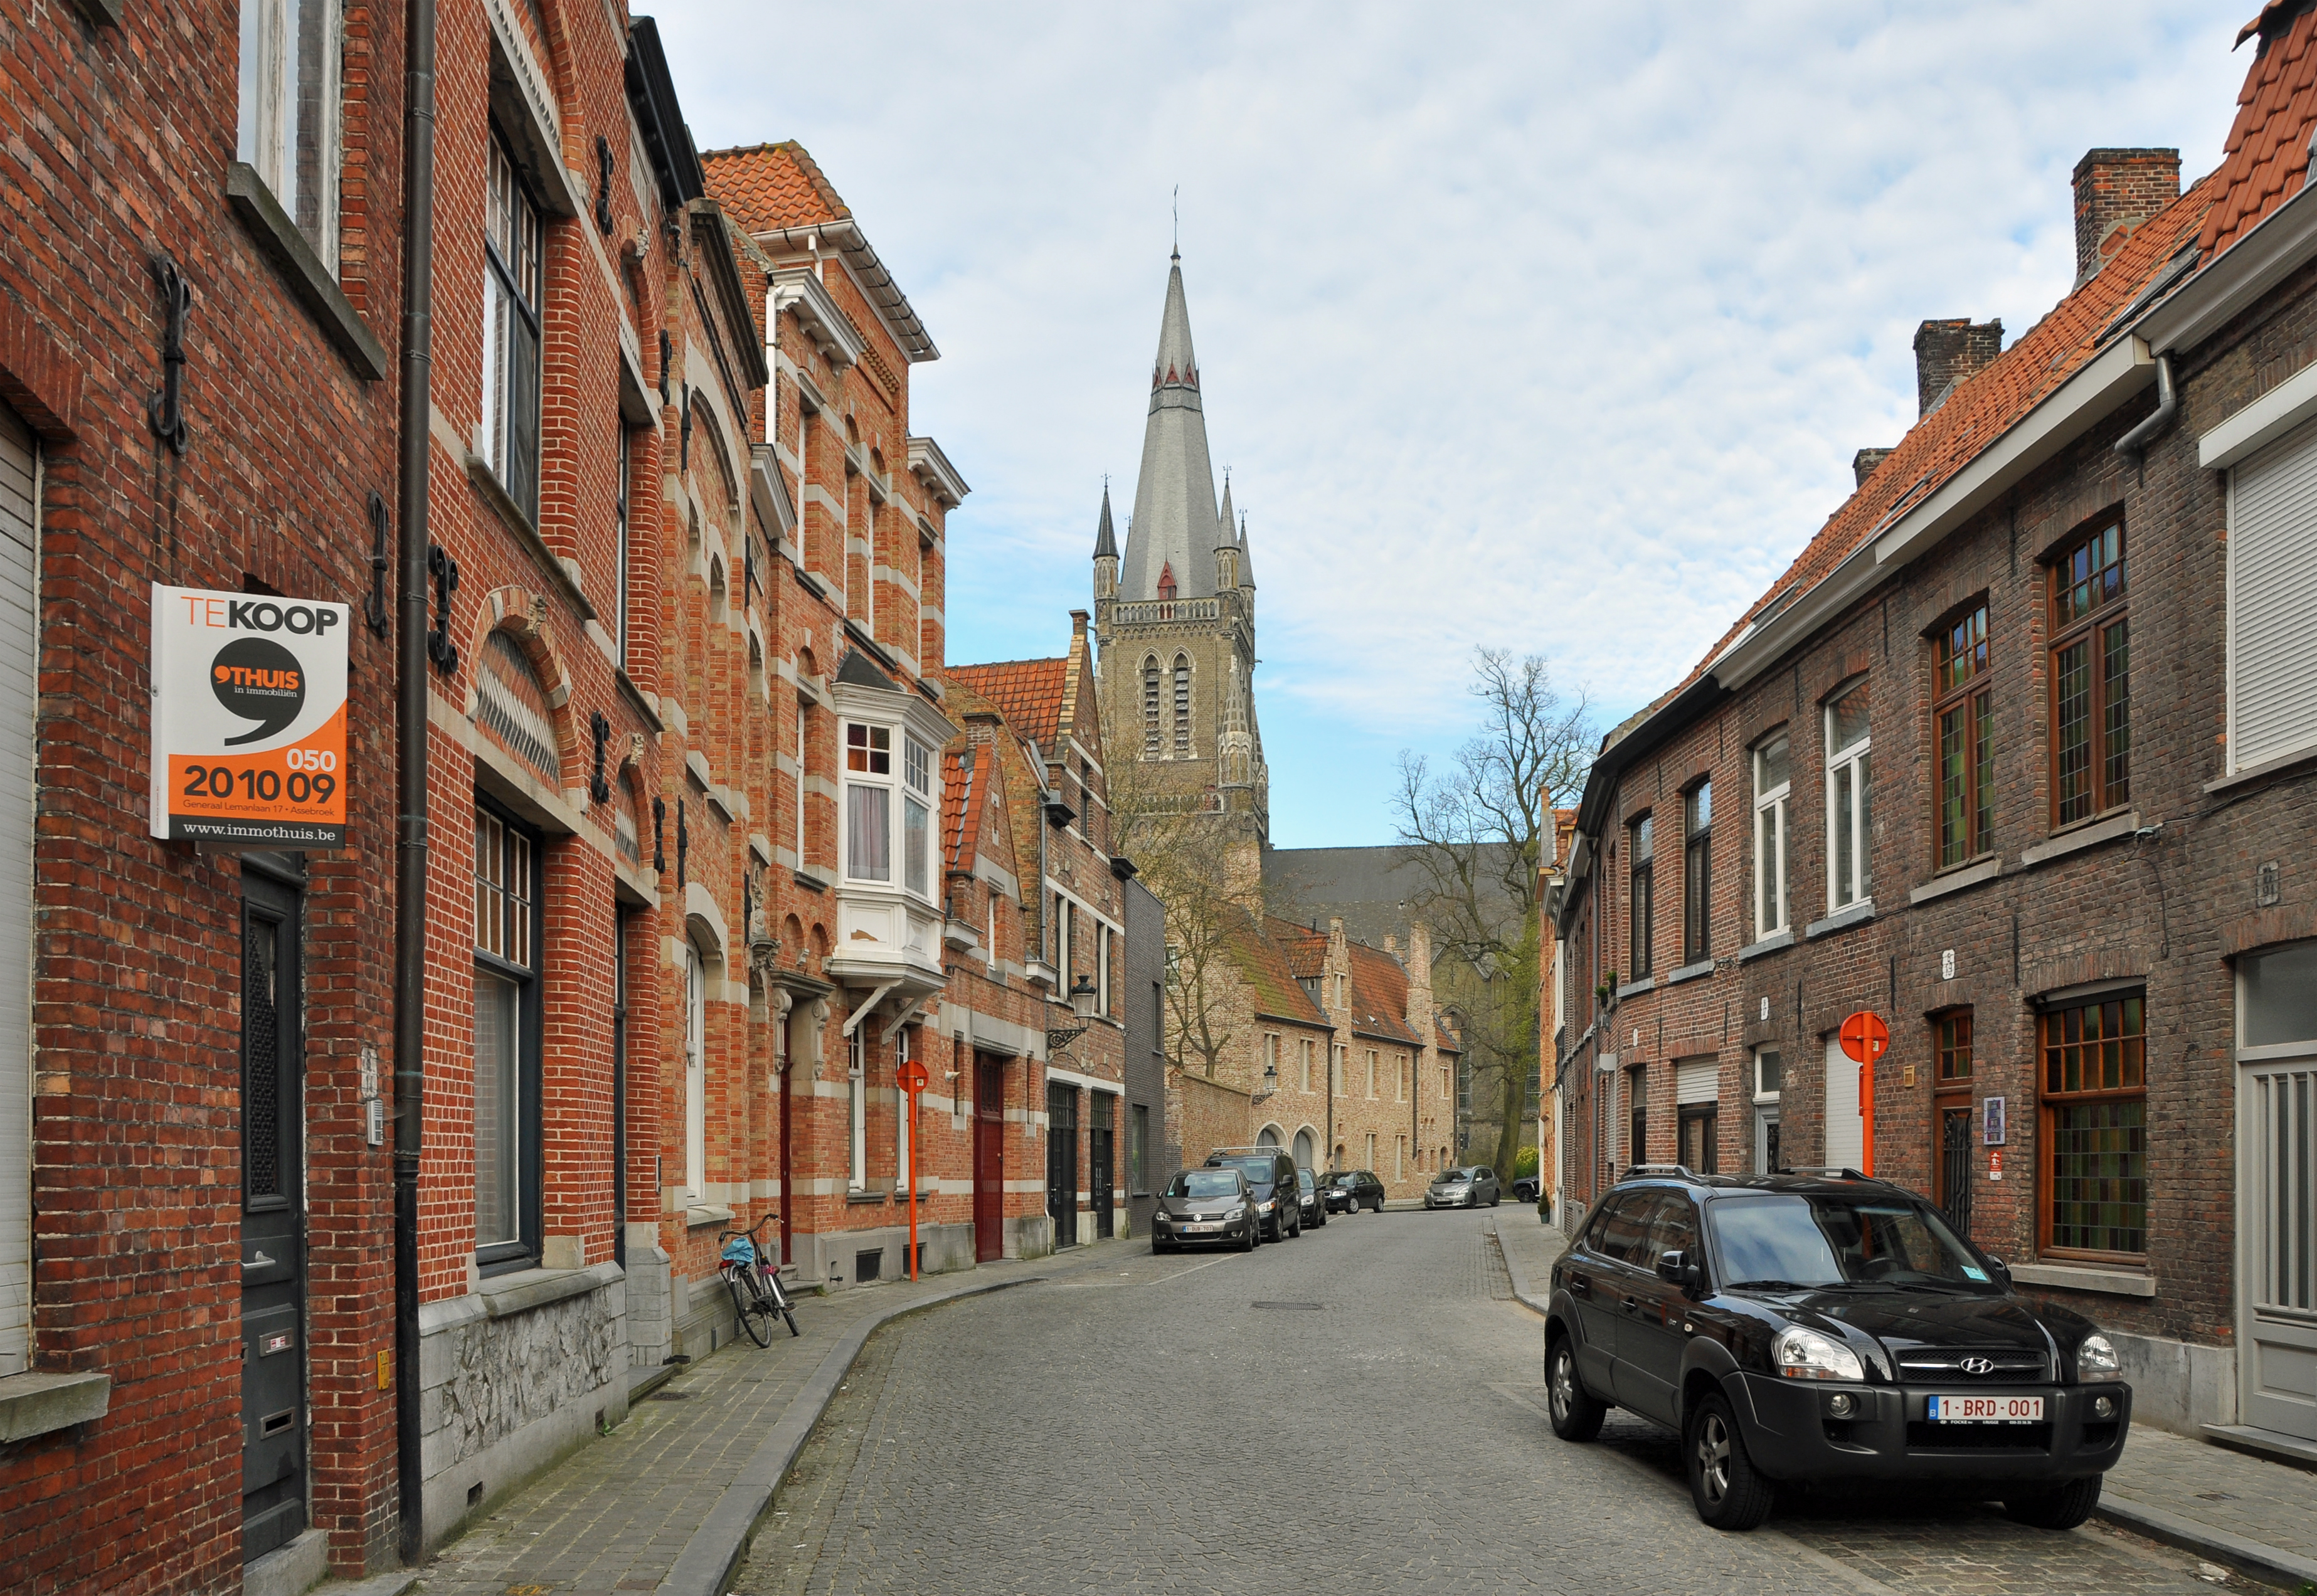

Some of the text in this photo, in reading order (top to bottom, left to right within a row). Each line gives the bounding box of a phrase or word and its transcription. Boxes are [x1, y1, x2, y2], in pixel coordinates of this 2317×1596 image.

[229, 600, 339, 636] KOOP
[234, 685, 298, 698] in immobiliën
[287, 748, 336, 772] 050
[184, 764, 336, 804] 20 10 09
[183, 800, 335, 816] Generaal Lemanlaan 17 Assebroek
[183, 824, 336, 841] www.immothuis.be
[1943, 1400, 2040, 1417] 1-BRD-001
